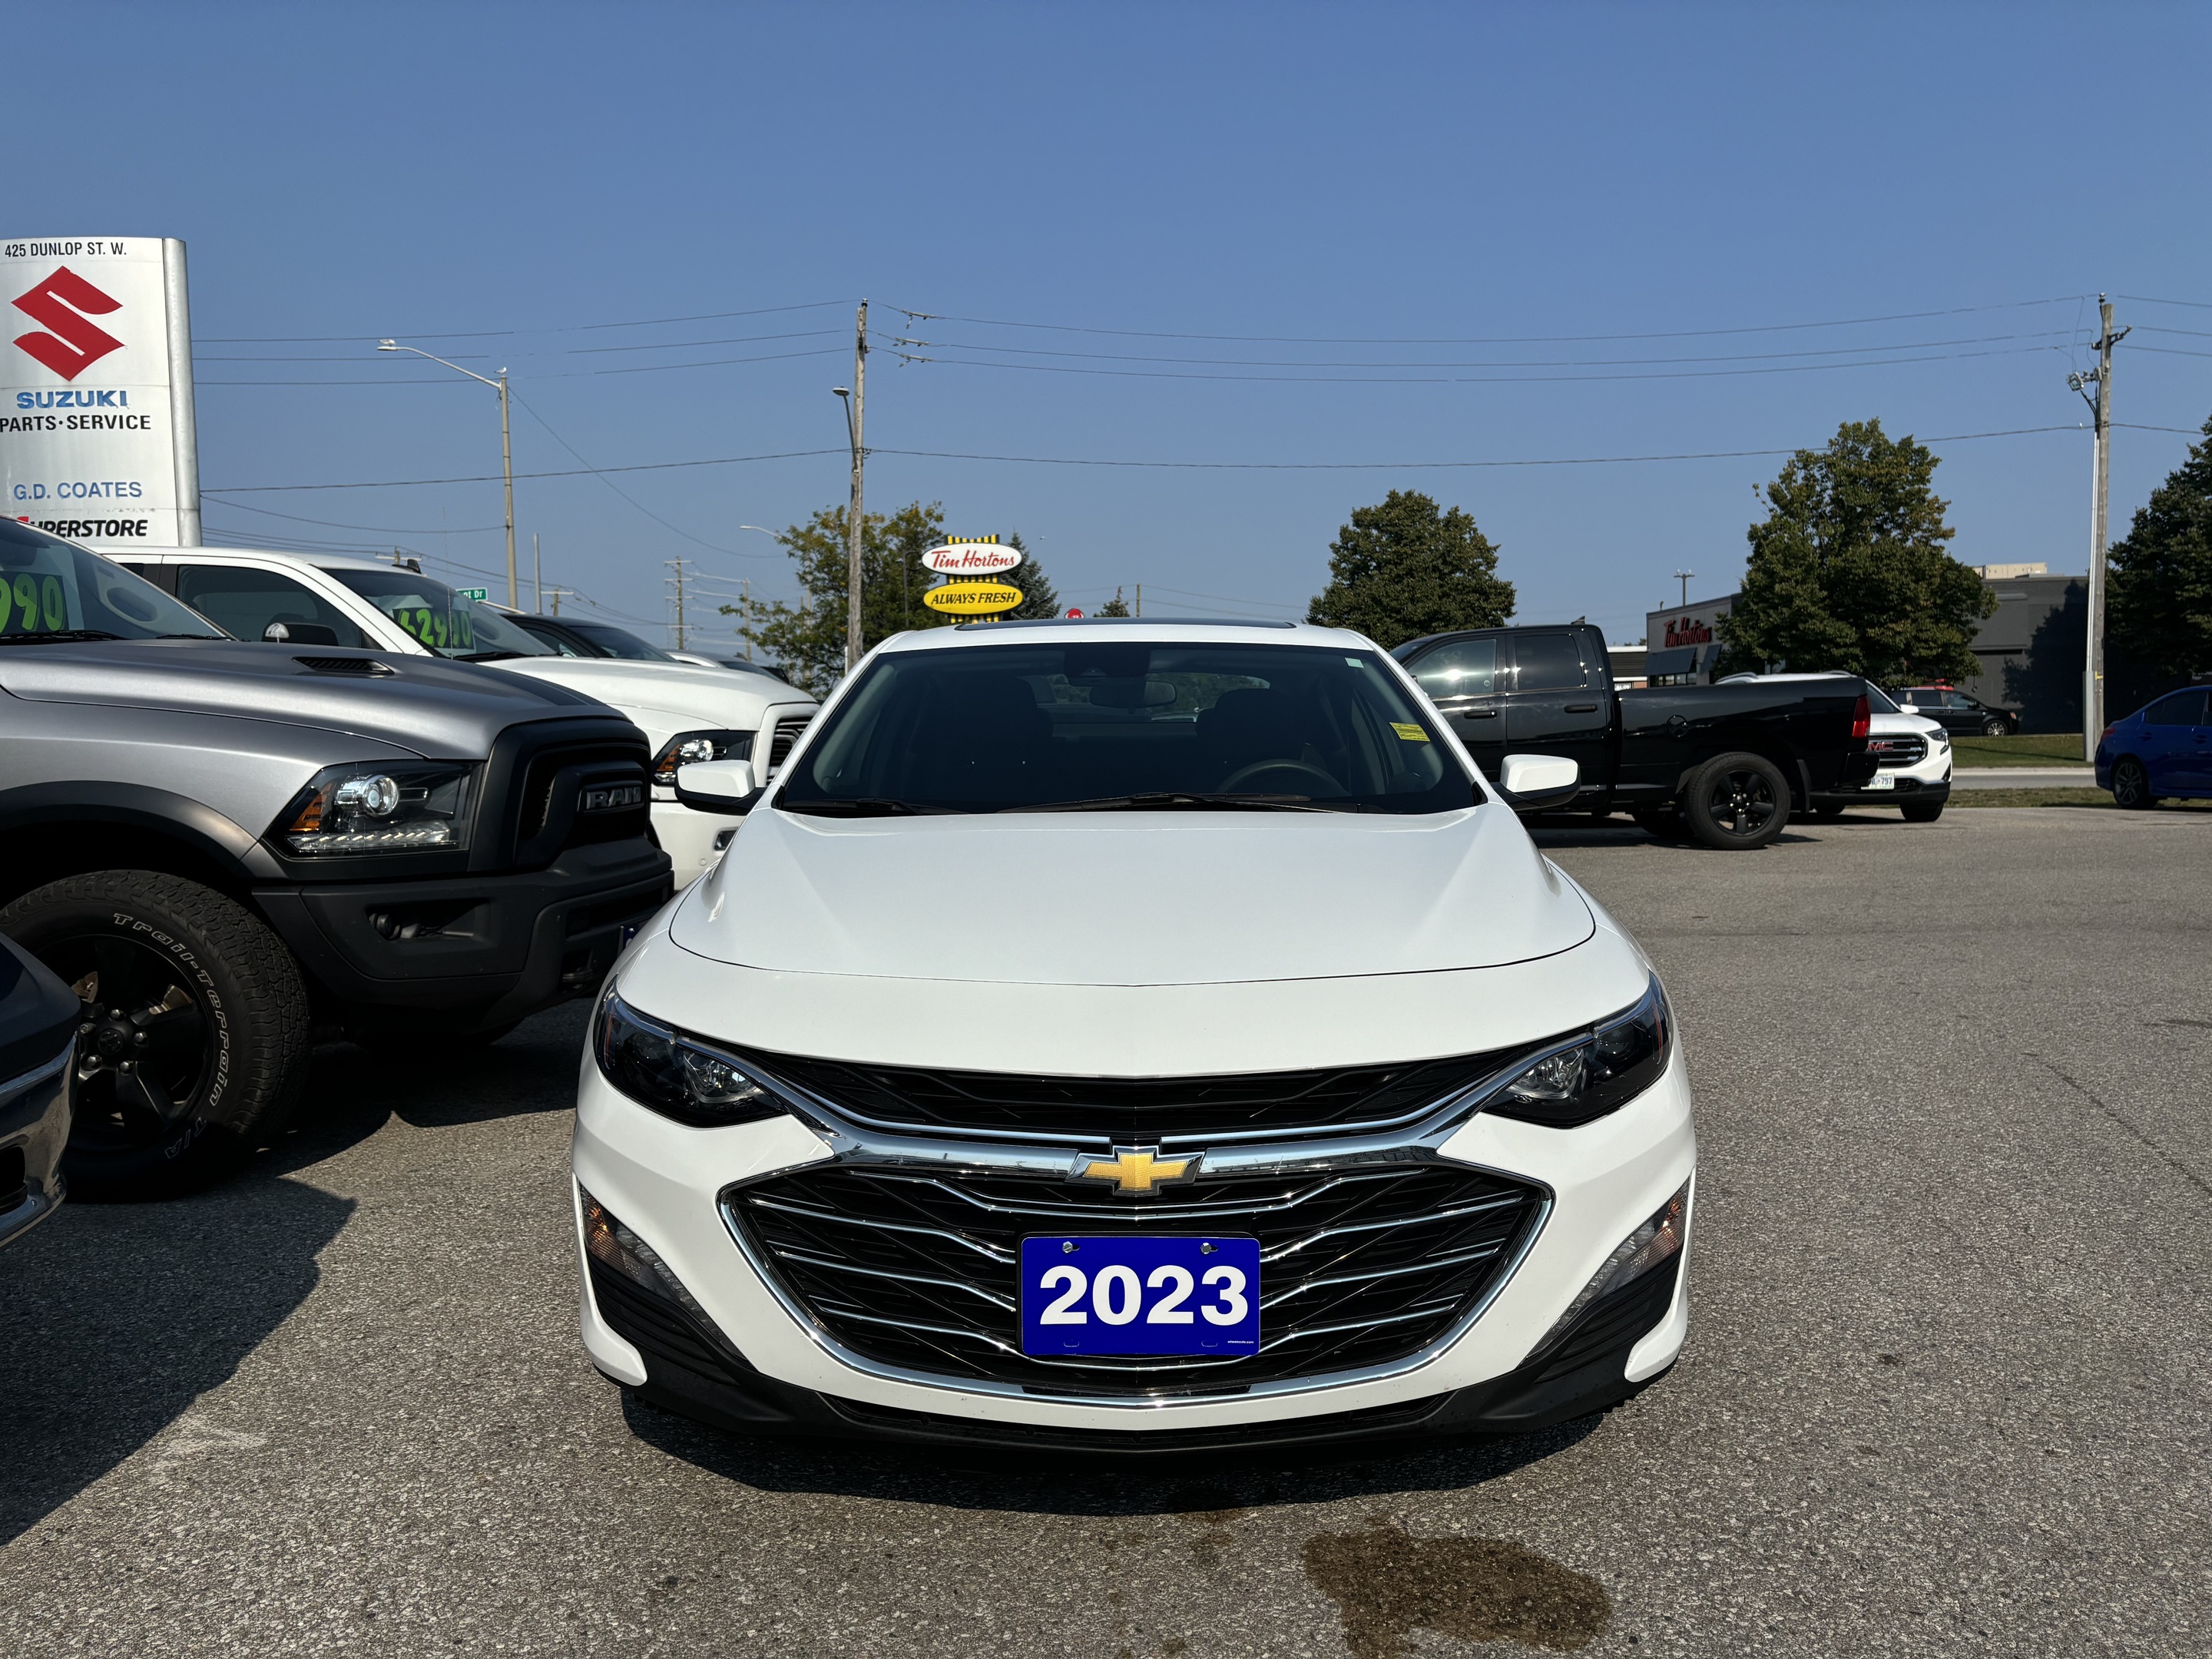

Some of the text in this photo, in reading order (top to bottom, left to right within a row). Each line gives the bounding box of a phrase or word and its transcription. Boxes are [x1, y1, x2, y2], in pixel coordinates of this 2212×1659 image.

[5, 242, 127, 257] 425 DUNLOP ST. W.
[16, 390, 127, 409] SUZUKI
[14, 482, 143, 501] G.D. COATES
[17, 515, 148, 538] PERSTORE
[931, 549, 1015, 568] Tim Hortons
[475, 590, 483, 598] Dr
[931, 592, 1016, 605] ALWAYS FRESH
[1869, 741, 1893, 752] MC
[586, 786, 641, 810] RAM
[1040, 1265, 1248, 1326] 2023
